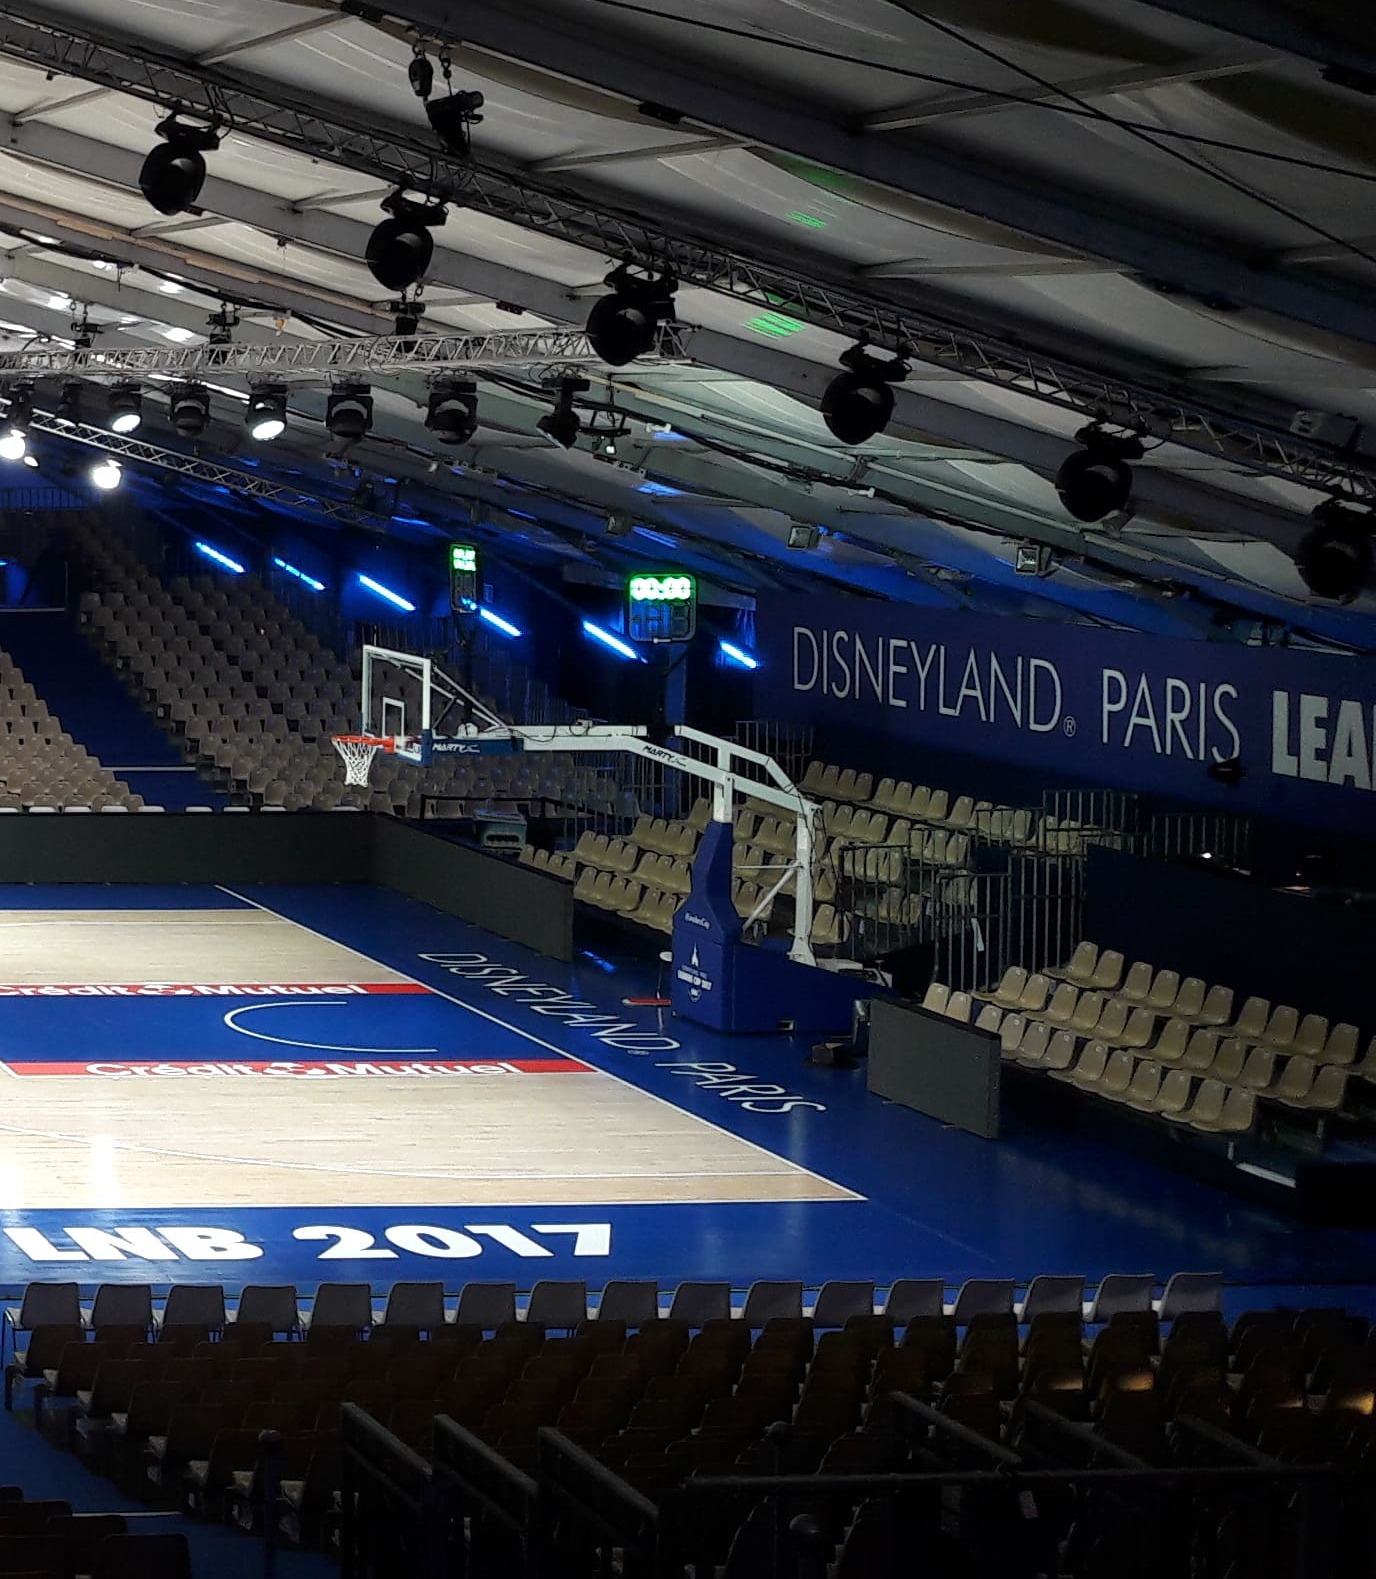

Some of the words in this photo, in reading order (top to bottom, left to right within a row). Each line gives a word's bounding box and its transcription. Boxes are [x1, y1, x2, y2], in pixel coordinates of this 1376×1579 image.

[1102, 668, 1240, 763] PARIS
[1271, 689, 1376, 791] LEA
[193, 984, 368, 996] Mutuel
[323, 1061, 524, 1077] Mutuel
[655, 1061, 827, 1113] PARIS
[2, 1226, 264, 1261] LNB
[292, 1223, 612, 1260] 2017
